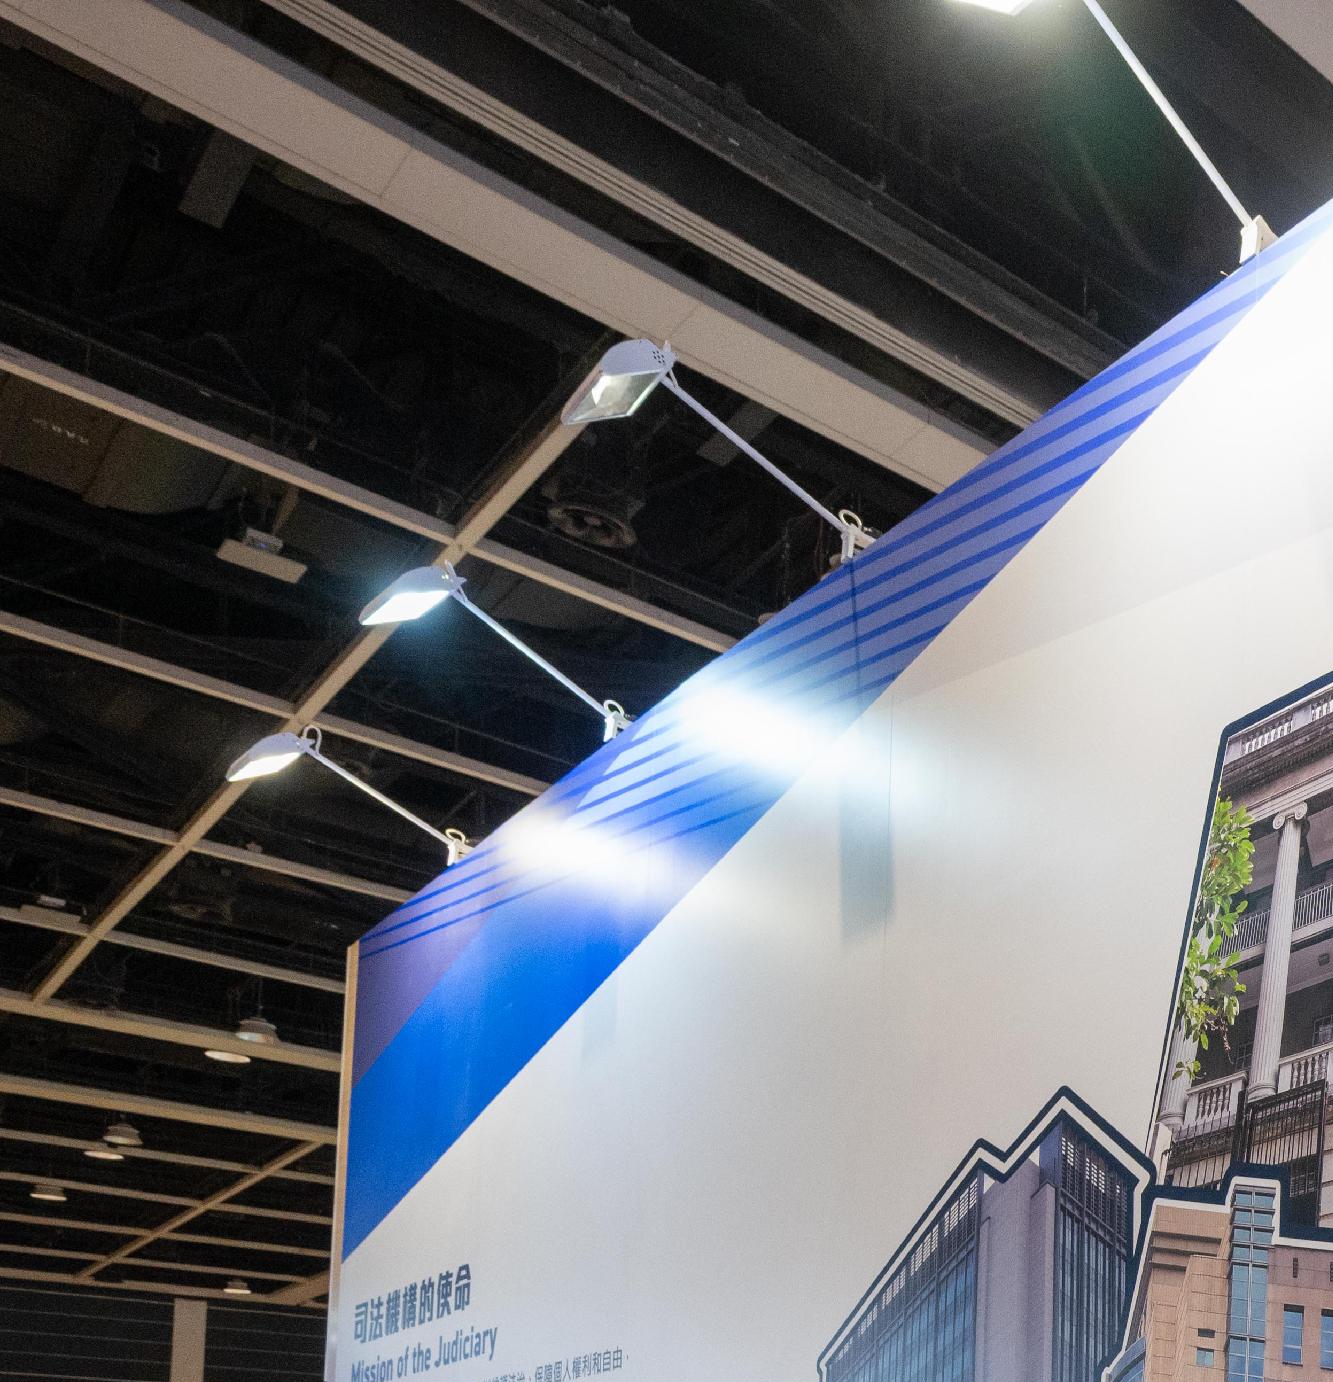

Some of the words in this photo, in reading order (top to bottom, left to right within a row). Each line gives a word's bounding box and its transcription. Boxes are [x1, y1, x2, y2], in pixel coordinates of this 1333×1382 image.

[353, 1263, 472, 1344] 司法機構的使命
[397, 1345, 410, 1378] of
[412, 1342, 432, 1374] the
[435, 1326, 498, 1368] Judiciary
